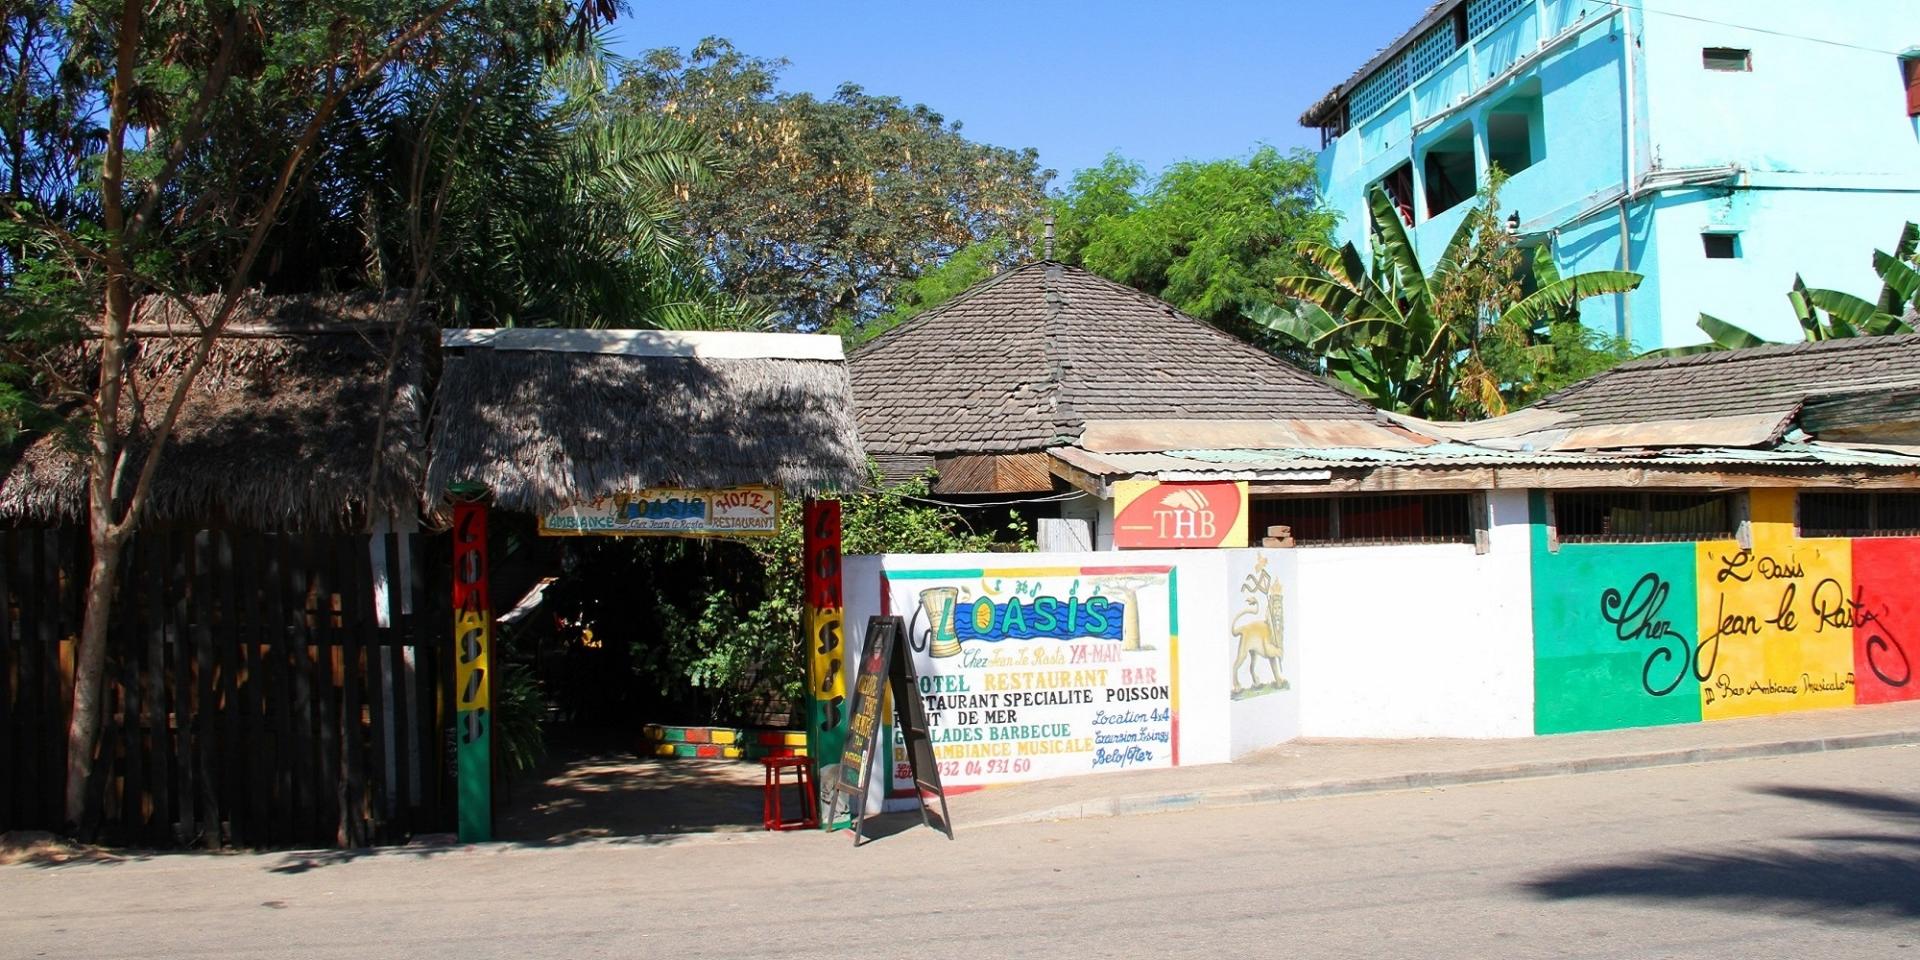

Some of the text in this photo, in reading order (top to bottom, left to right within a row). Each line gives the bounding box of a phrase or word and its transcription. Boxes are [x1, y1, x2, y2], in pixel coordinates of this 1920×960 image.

[715, 490, 774, 515] HOTEL
[549, 515, 615, 529] AMBIANCE
[714, 516, 775, 529] RESTAURANT
[1153, 509, 1216, 539] THB
[1601, 572, 1691, 697] Chez
[957, 647, 988, 669] Chez
[1031, 645, 1066, 667] Rasta
[1069, 643, 1122, 665] YA-MAN
[917, 667, 1157, 696] OTEL RESTAURANT BAR
[1003, 688, 1094, 707] SPECIALITE
[1105, 685, 1169, 703] POISSON
[957, 709, 979, 725] DE
[984, 708, 1018, 724] MER
[1092, 709, 1149, 725] Location
[894, 726, 983, 746] GLADES
[989, 723, 1071, 740] BARBECUE
[1016, 737, 1094, 756] MUSICALE
[964, 763, 982, 777] 04
[985, 761, 1009, 776] 931
[1012, 758, 1031, 772] 60
